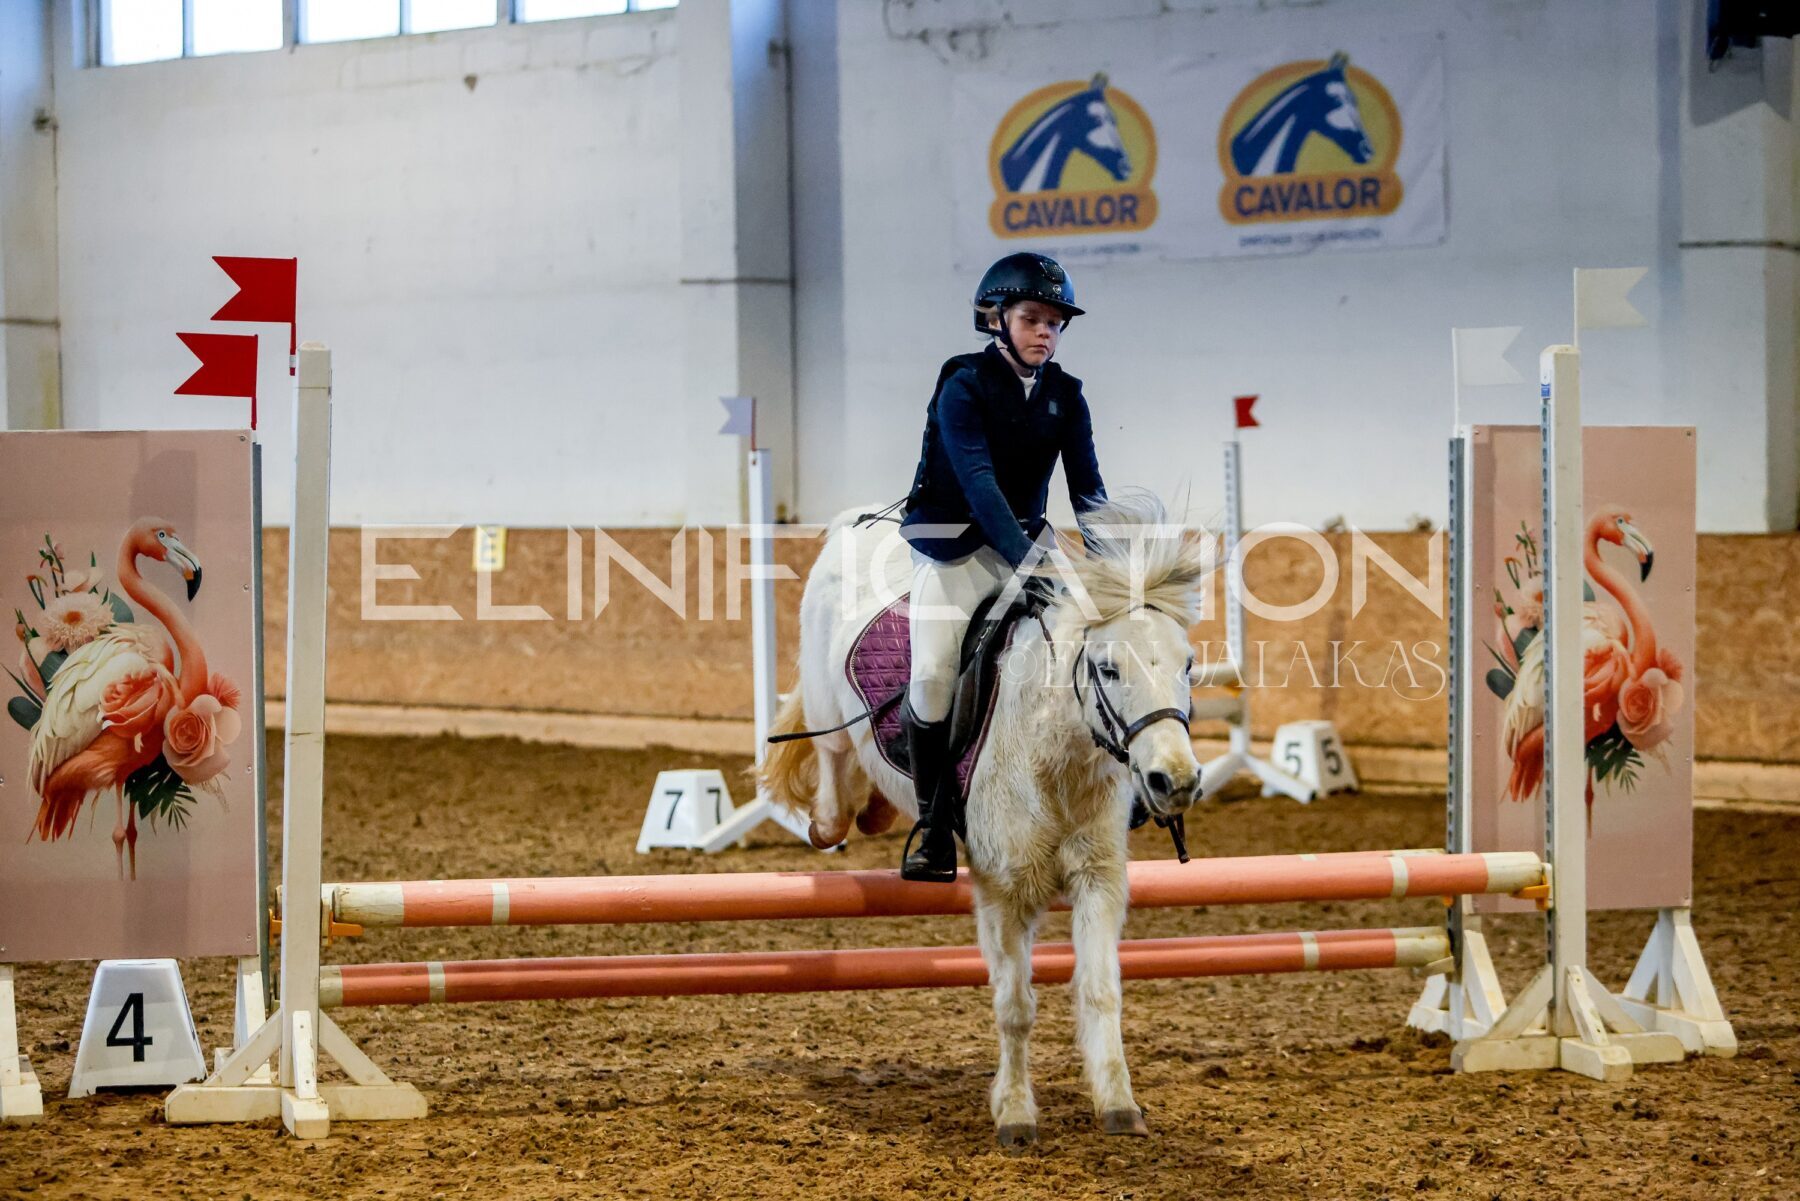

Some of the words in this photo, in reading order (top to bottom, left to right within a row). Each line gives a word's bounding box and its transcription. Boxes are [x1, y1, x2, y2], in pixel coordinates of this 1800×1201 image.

[1004, 193, 1139, 231] CAVALOR
[1235, 177, 1381, 217] CAVALOR
[1285, 741, 1301, 776] 5
[1321, 737, 1342, 775] 5
[665, 790, 683, 830] 7
[707, 788, 721, 824] 7
[106, 993, 153, 1062] 4
